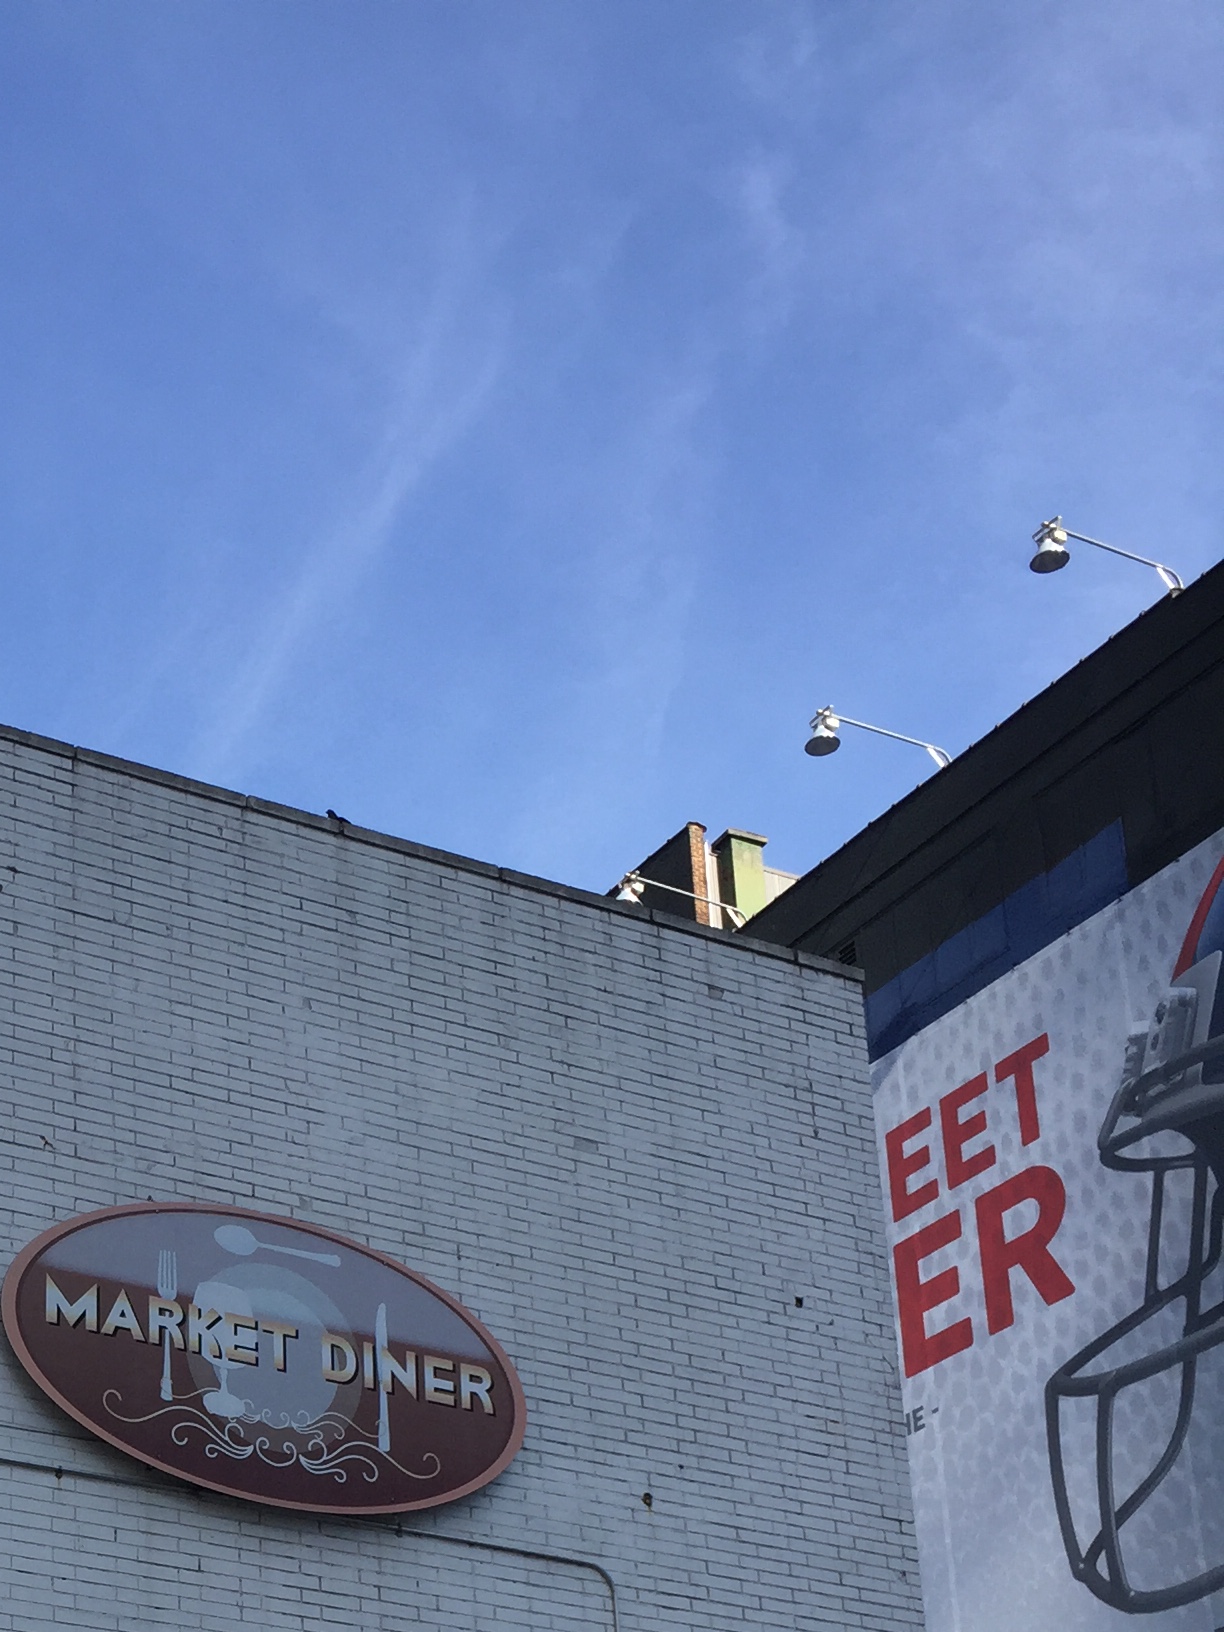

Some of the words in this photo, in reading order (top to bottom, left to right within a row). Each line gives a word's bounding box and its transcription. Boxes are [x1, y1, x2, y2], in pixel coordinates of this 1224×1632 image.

[885, 1032, 1050, 1224] EET
[44, 1273, 300, 1374] MARKET
[321, 1333, 496, 1416] DINER
[892, 1164, 1076, 1379] ER
